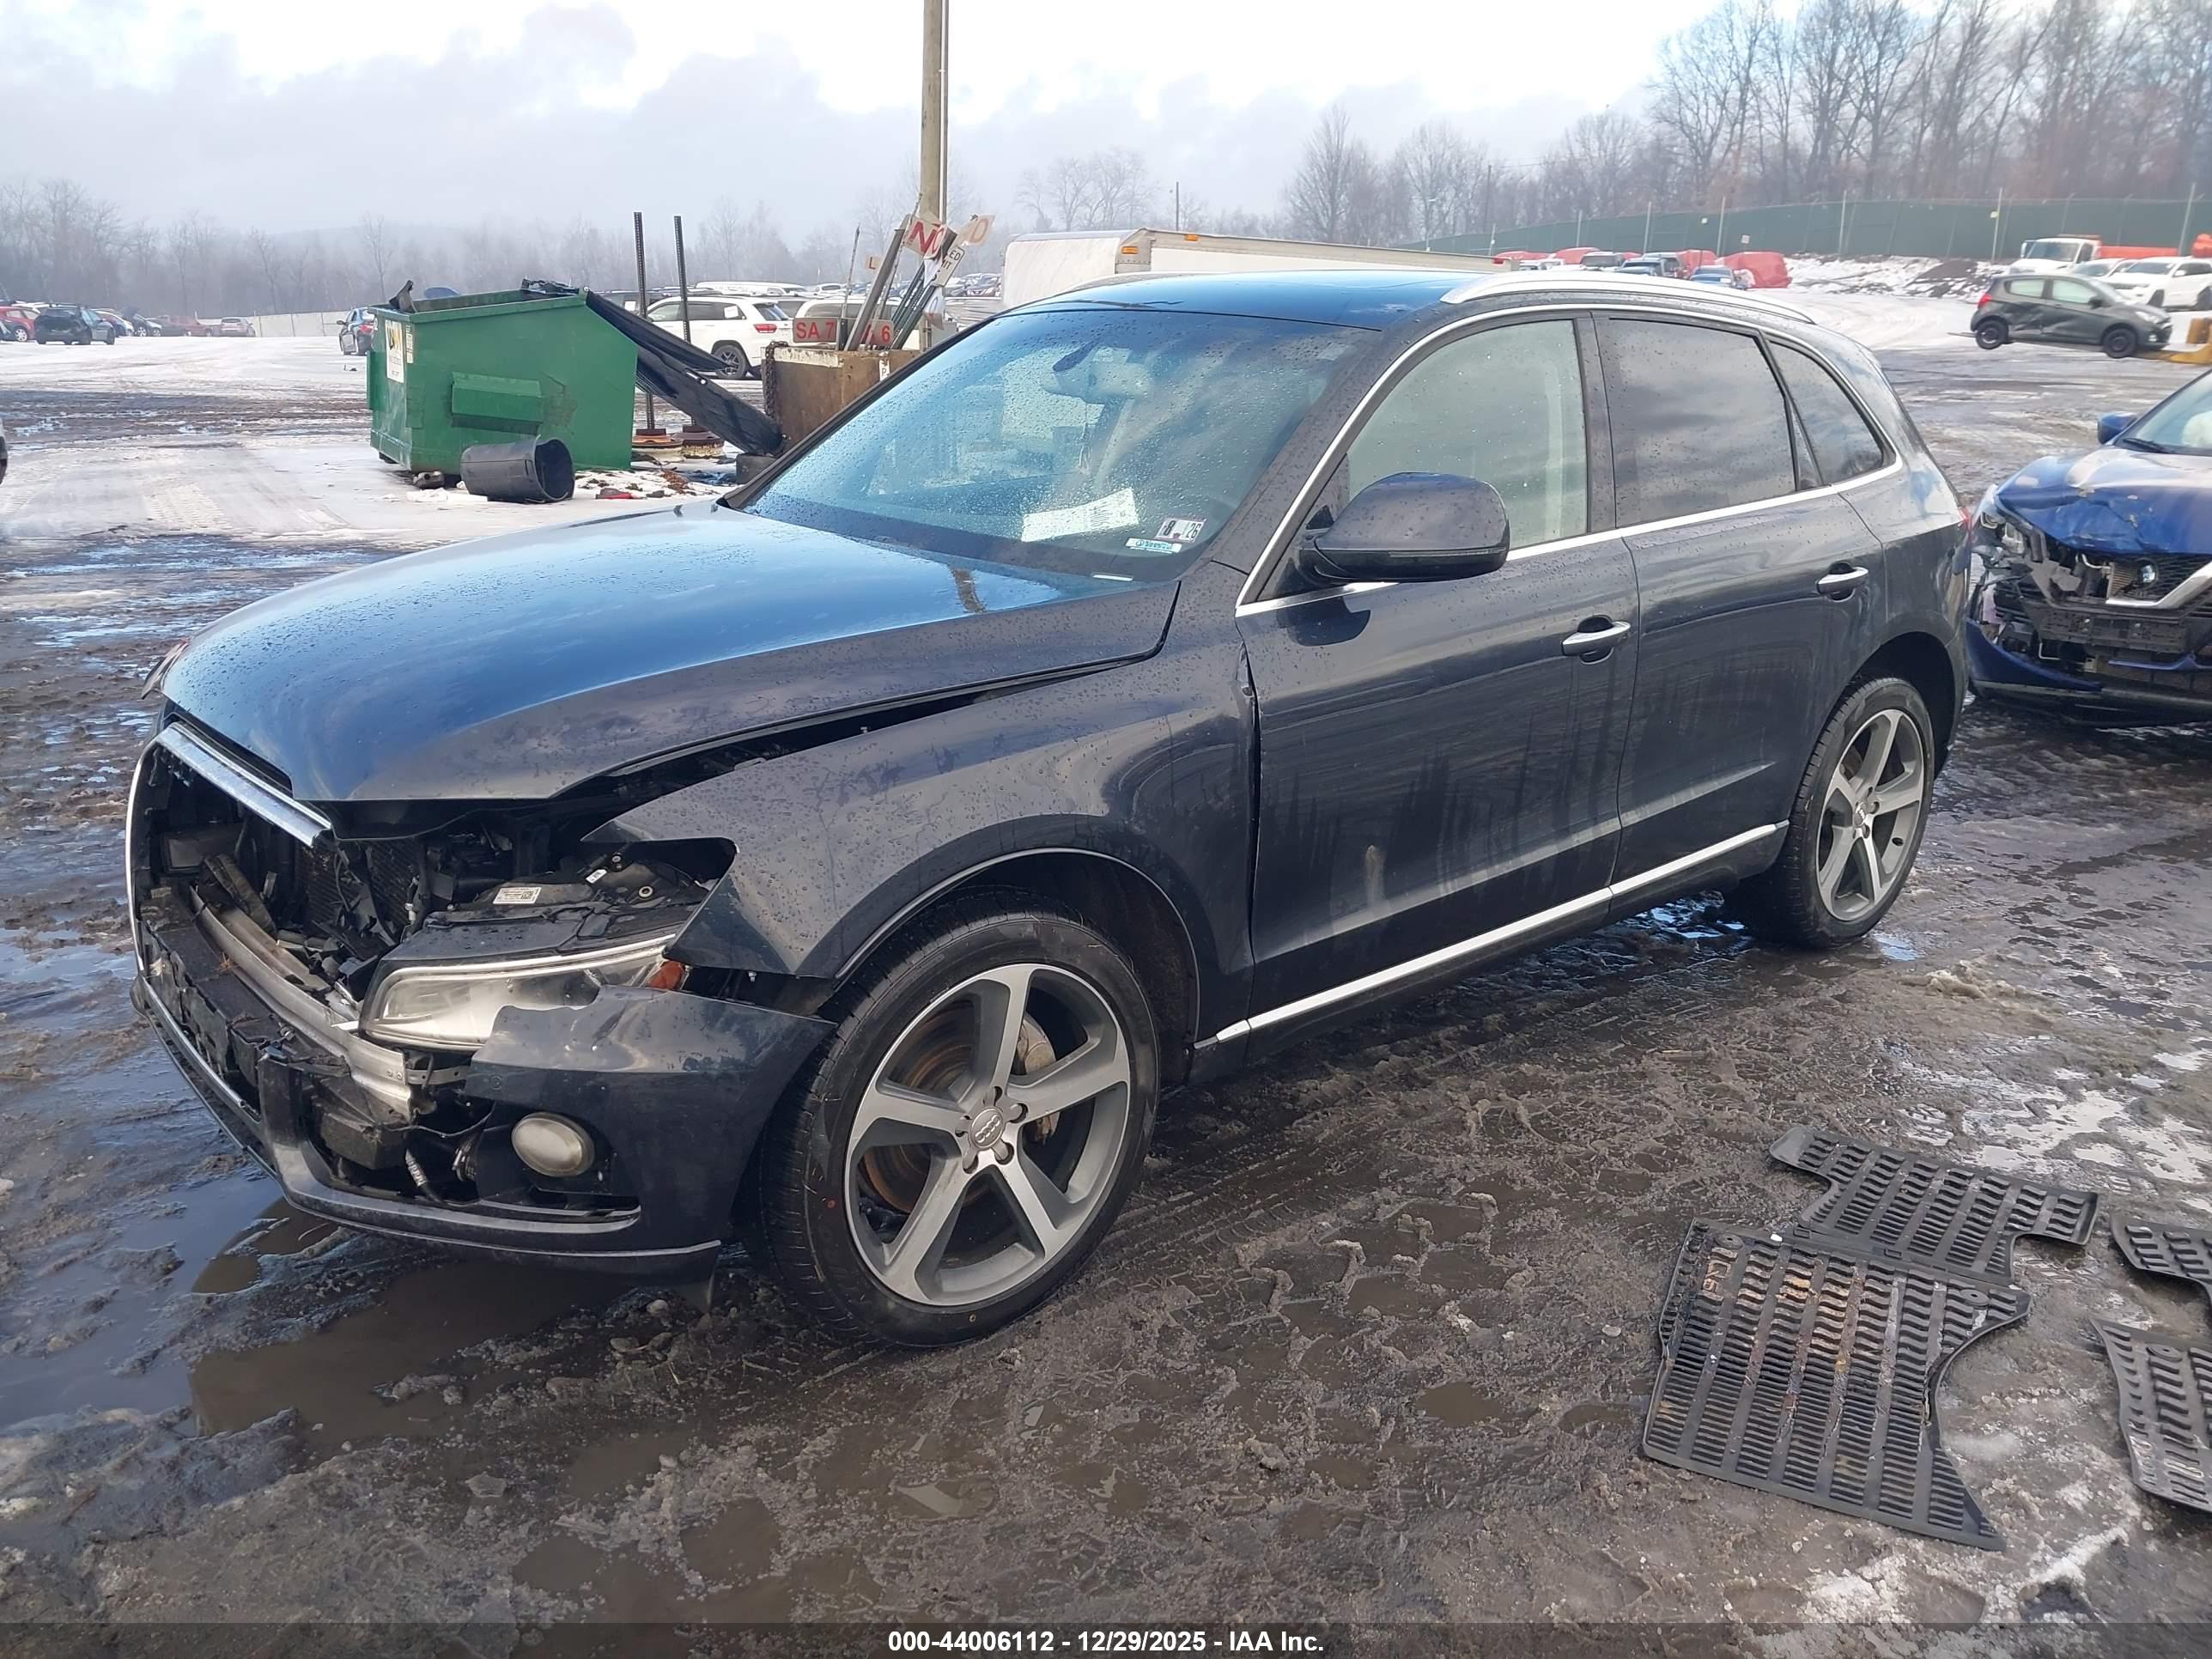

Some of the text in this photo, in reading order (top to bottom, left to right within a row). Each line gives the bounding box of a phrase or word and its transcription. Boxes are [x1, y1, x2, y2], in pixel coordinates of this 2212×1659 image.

[796, 321, 835, 338] SA 7
[882, 325, 890, 343] 6
[1163, 520, 1201, 538] 8 26
